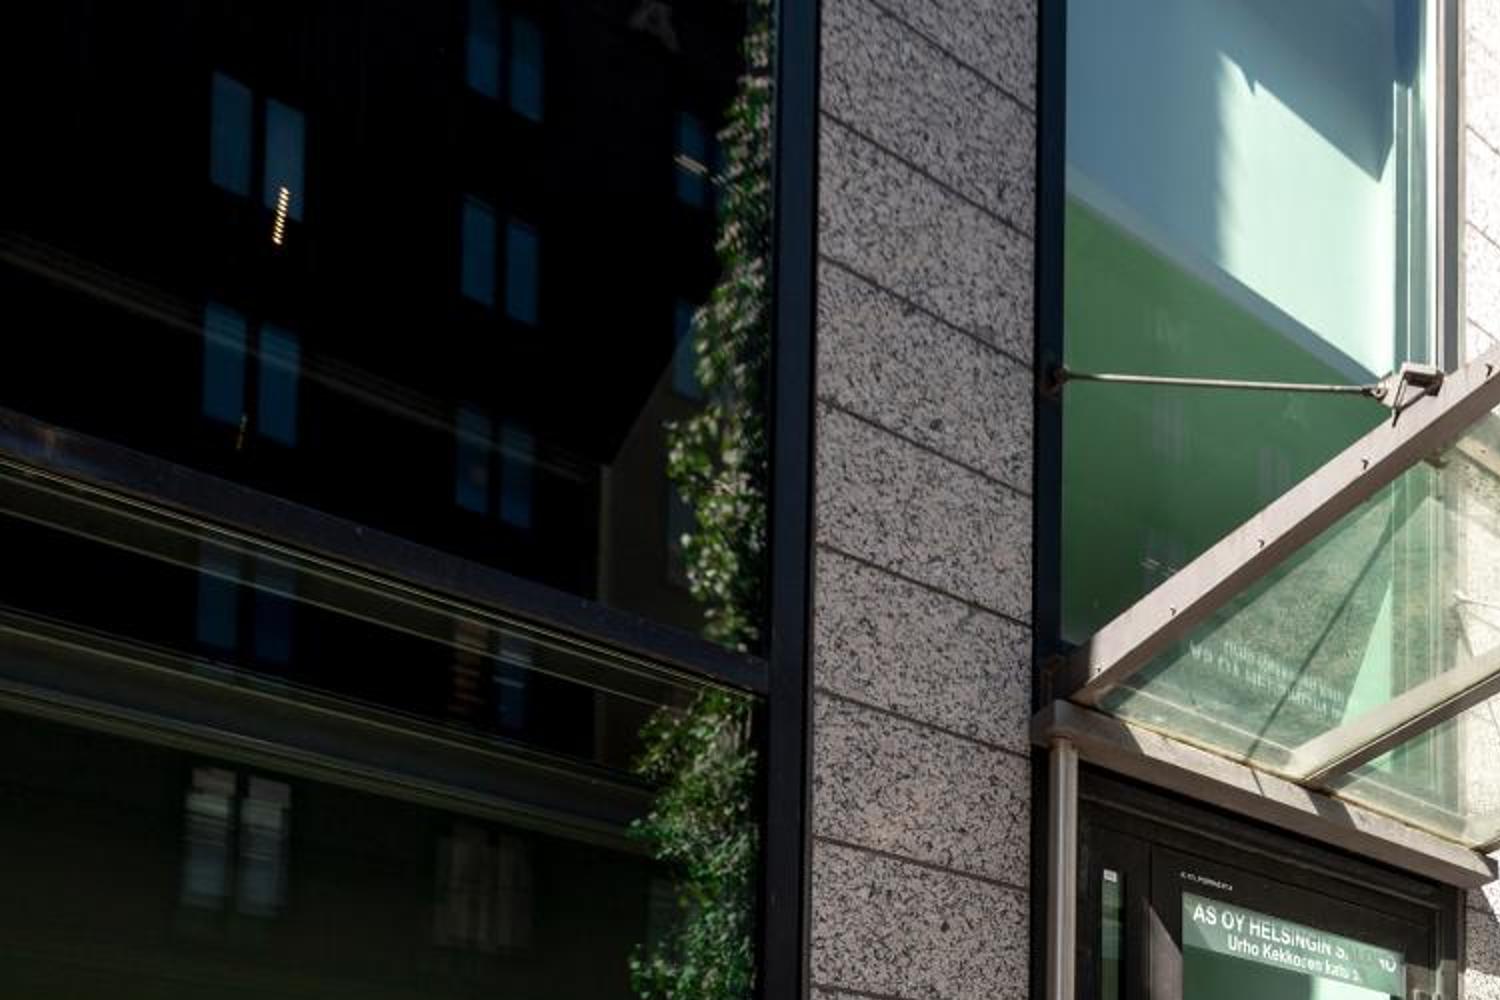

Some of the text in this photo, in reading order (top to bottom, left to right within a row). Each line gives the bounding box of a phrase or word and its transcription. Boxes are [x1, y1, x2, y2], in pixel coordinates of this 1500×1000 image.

[1192, 904, 1217, 926] AS
[1221, 911, 1246, 932] OY
[1249, 920, 1332, 956] HELSINGIN
[1227, 934, 1259, 957] Urho
